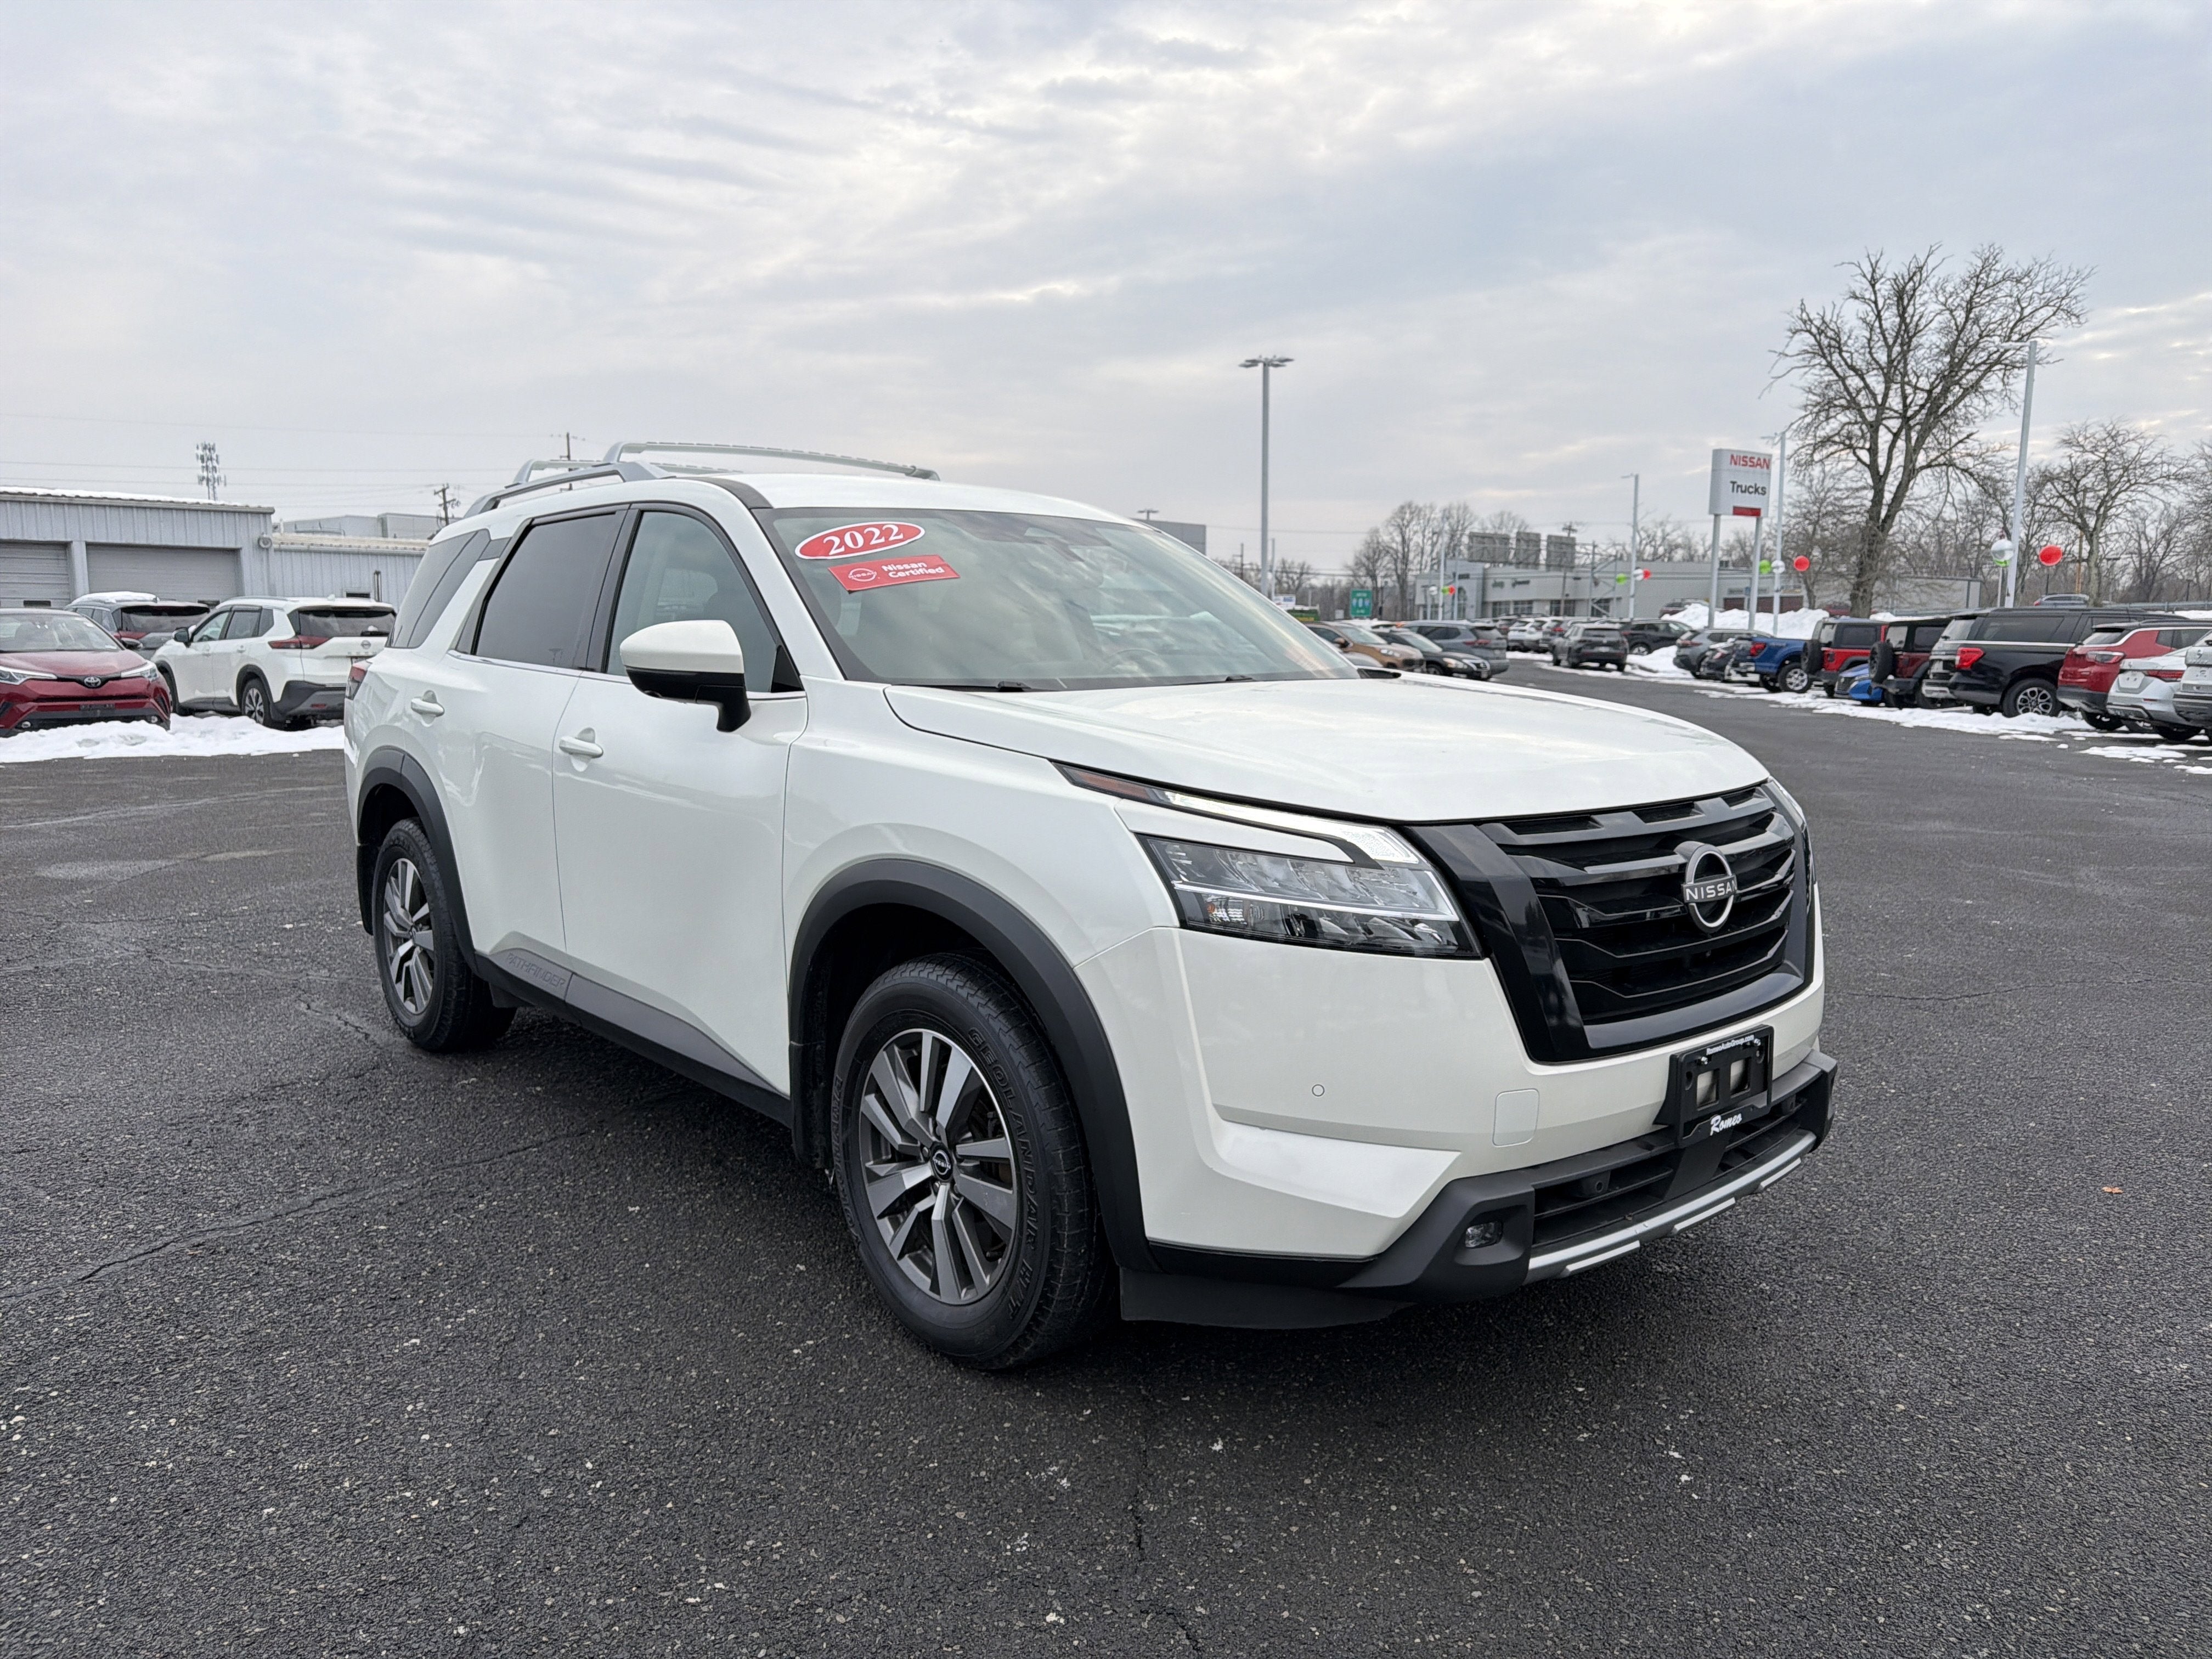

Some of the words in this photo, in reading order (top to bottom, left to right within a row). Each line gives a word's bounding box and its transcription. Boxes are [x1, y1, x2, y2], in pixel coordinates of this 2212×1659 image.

[1730, 454, 1770, 470] NISSAN
[1730, 481, 1767, 496] Trucks
[823, 524, 904, 555] 2022
[882, 562, 927, 572] Nissan
[888, 566, 945, 578] Certified
[1686, 879, 1737, 900] NISSAN
[506, 952, 566, 987] PATHFINDER
[1709, 1113, 1742, 1136] Romeo
